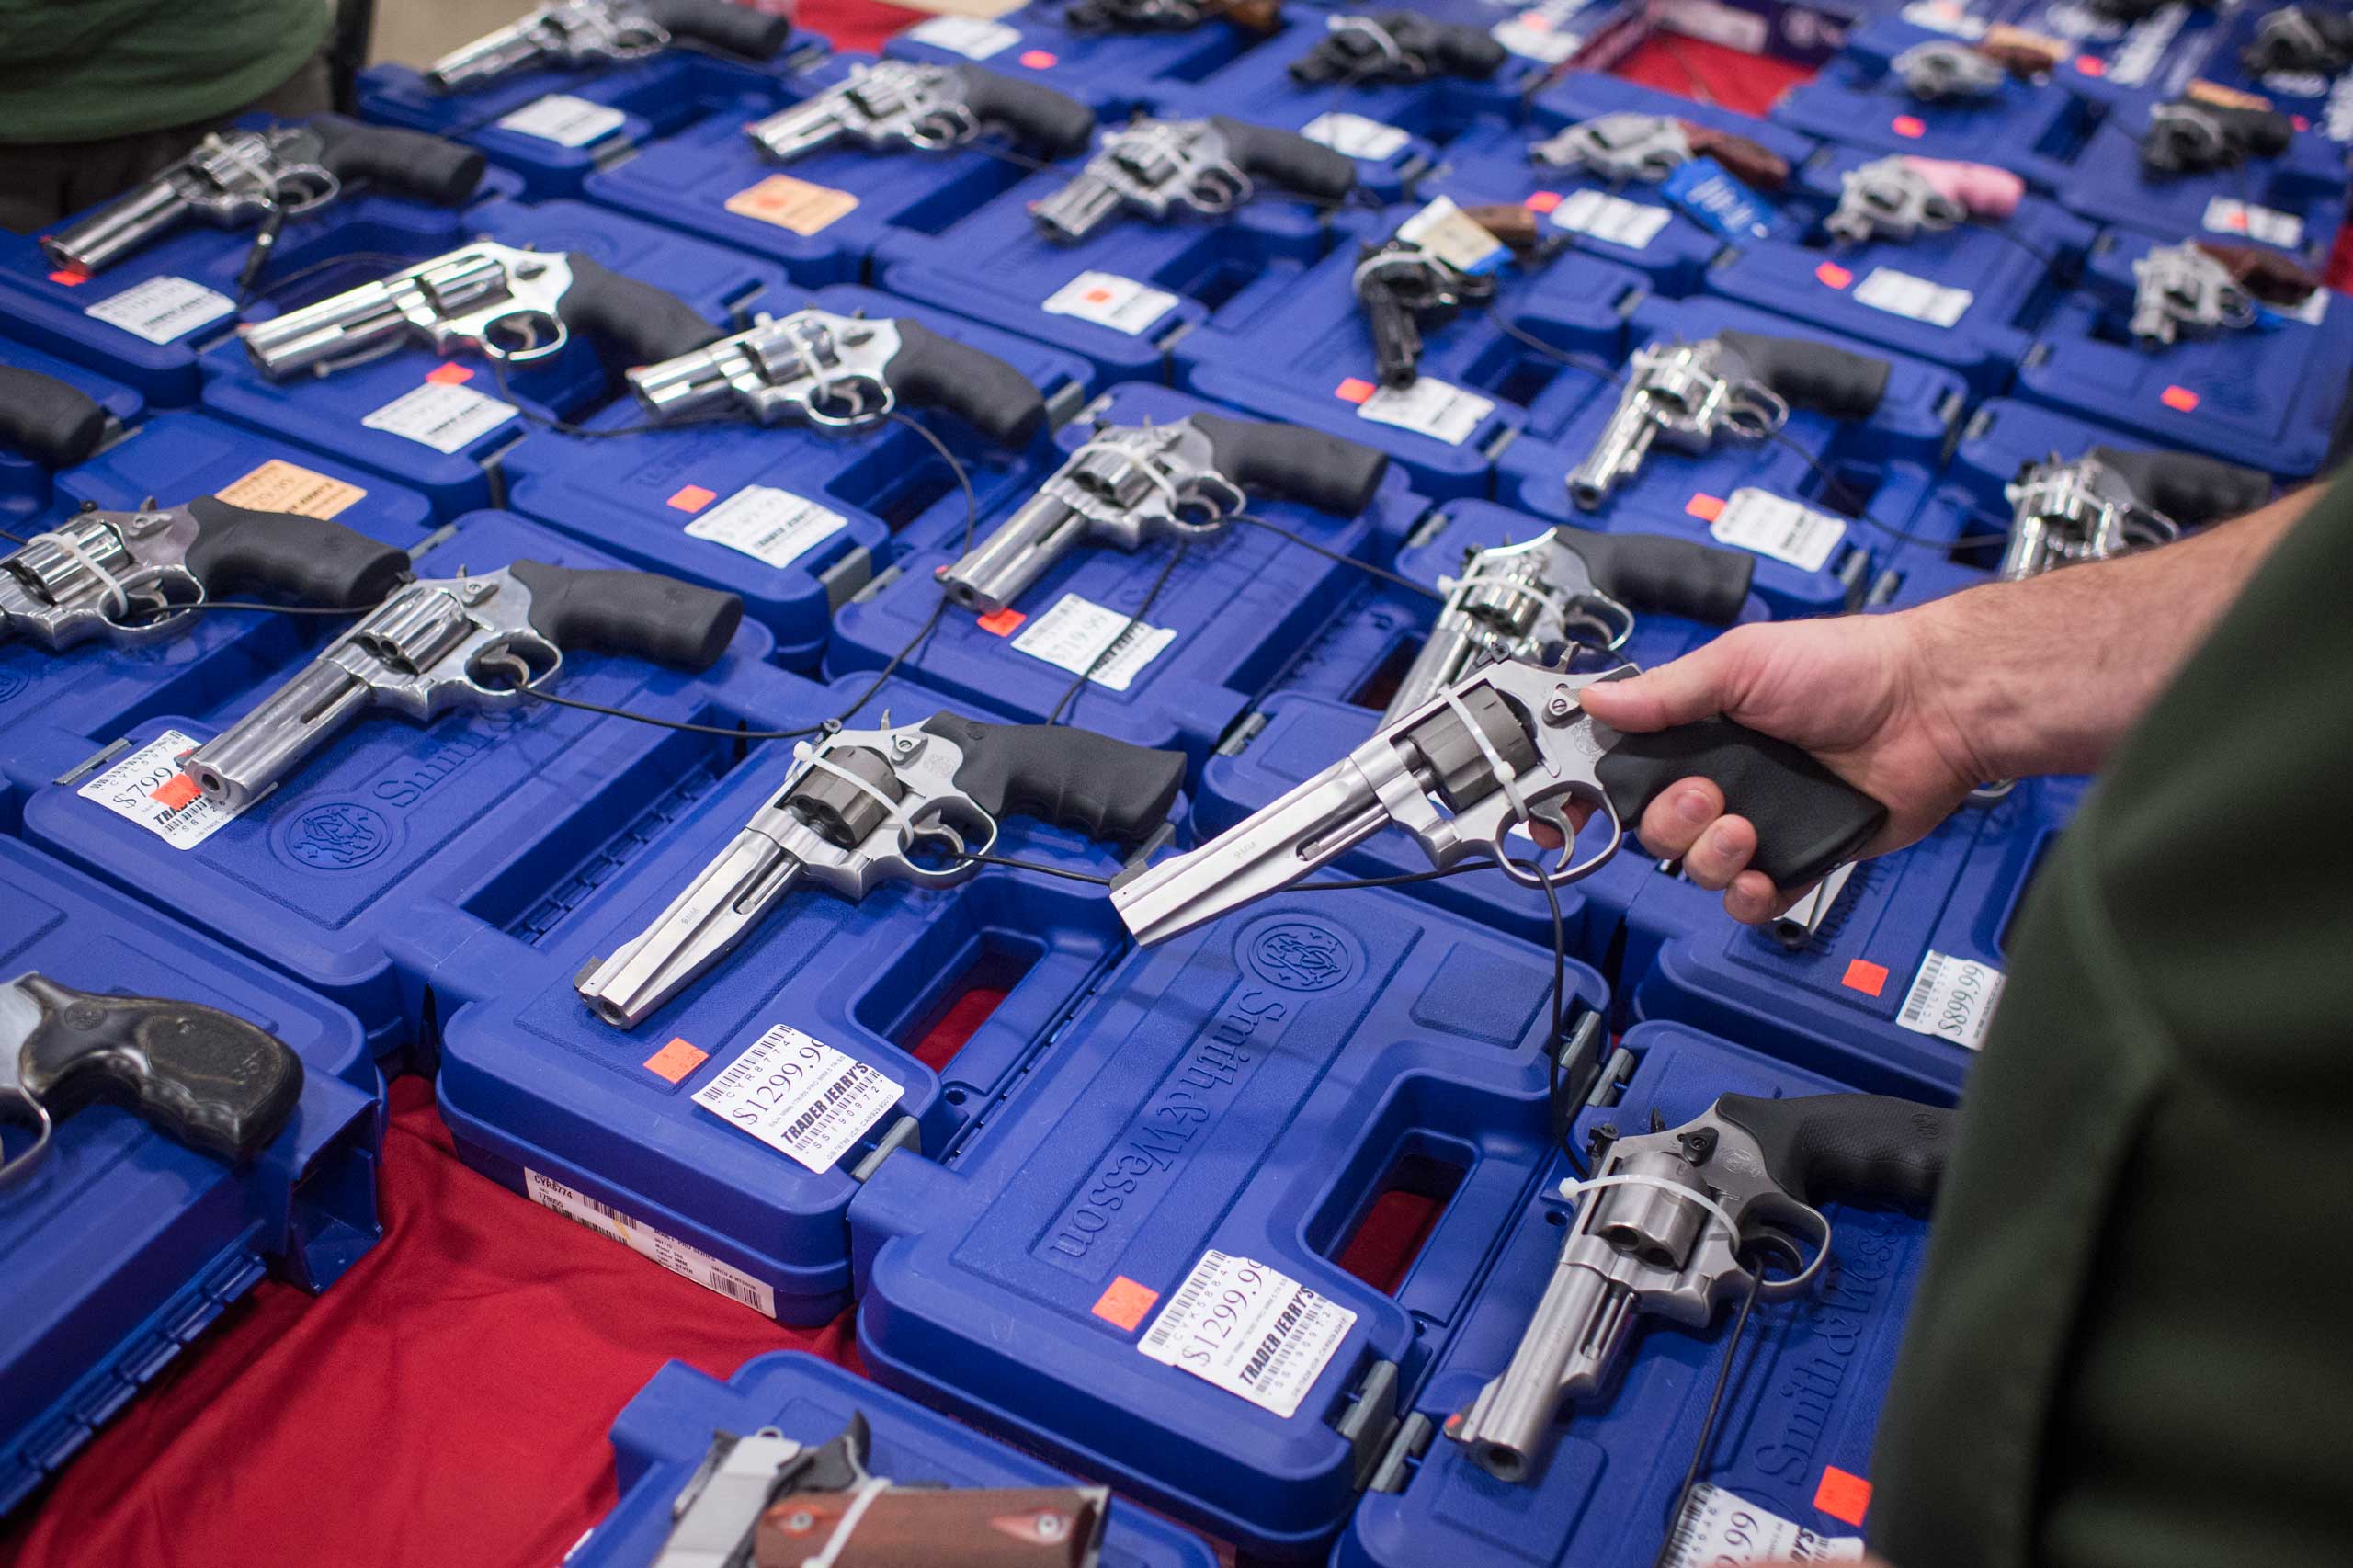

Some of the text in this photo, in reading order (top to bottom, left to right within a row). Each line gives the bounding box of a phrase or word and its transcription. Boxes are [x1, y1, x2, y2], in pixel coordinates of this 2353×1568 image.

[154, 794, 202, 825] TRA
[1179, 990, 1288, 1090] Smith
[1938, 964, 1985, 1037] $899.99
[725, 1040, 791, 1099] CYR8774
[781, 1062, 870, 1145] TRADER JERRY'S
[1049, 1126, 1199, 1259] Wesson
[1239, 1333, 1282, 1386] TRADER
[1274, 1286, 1315, 1338] JERRY'S
